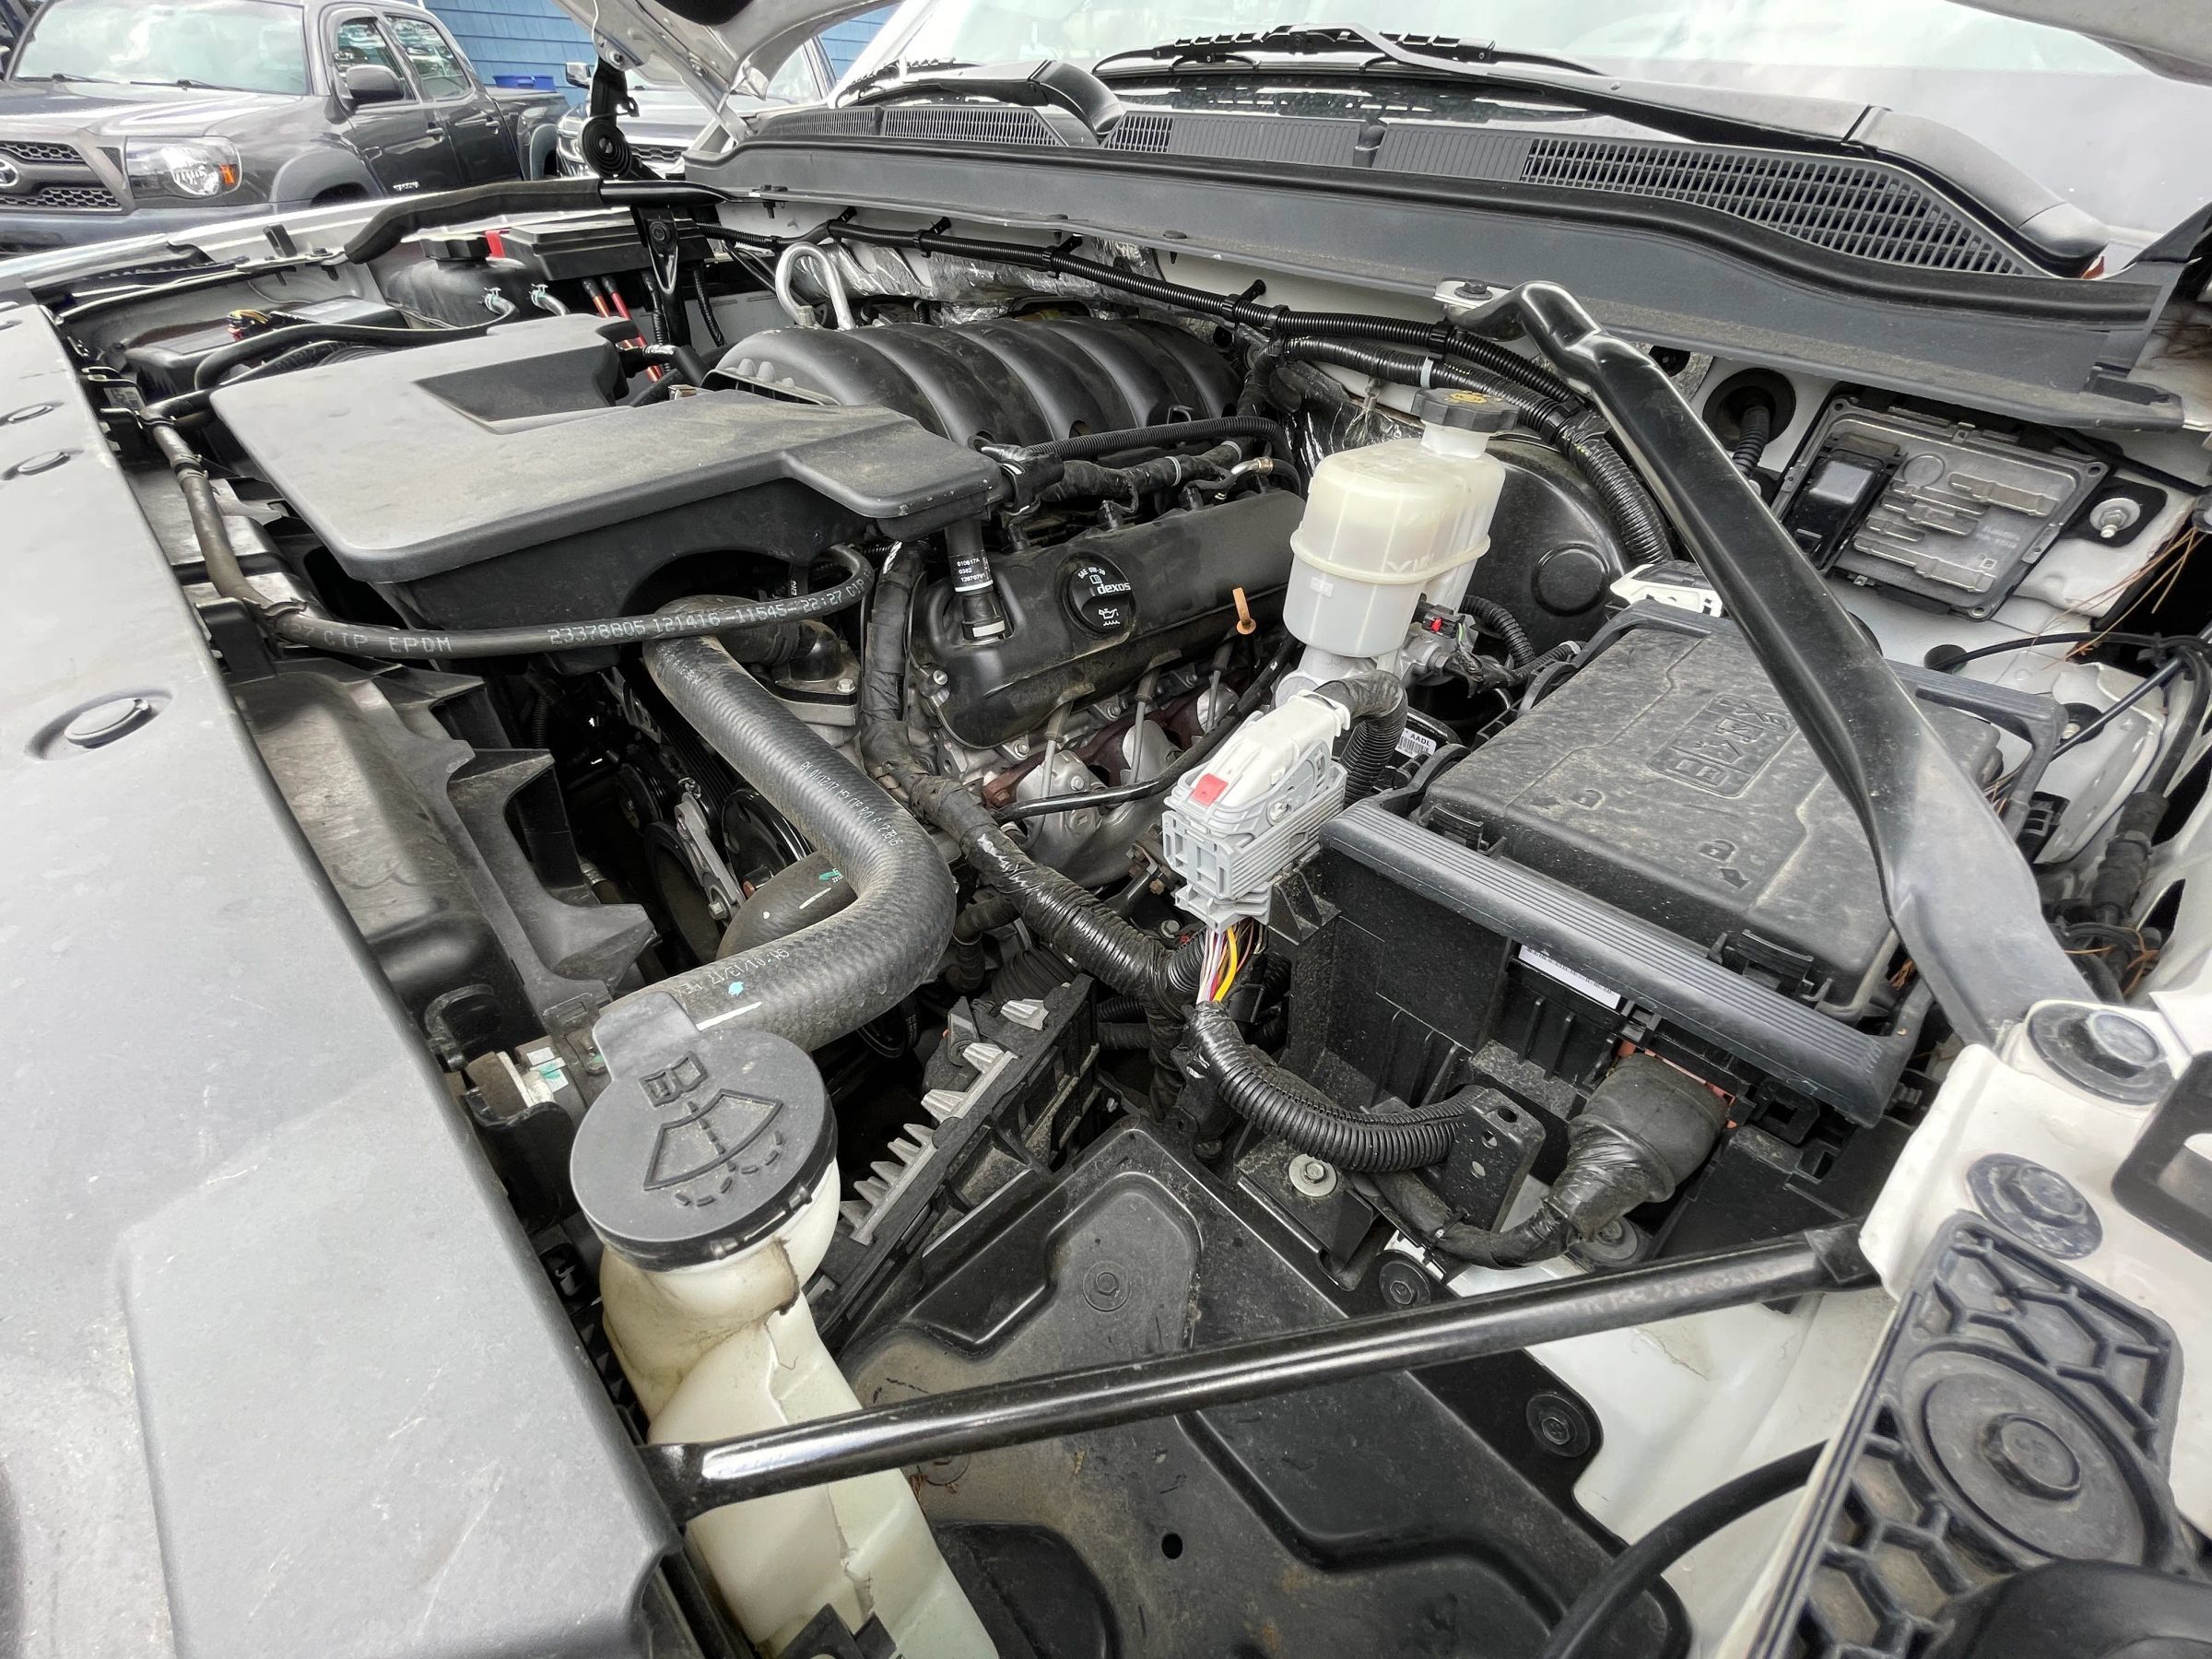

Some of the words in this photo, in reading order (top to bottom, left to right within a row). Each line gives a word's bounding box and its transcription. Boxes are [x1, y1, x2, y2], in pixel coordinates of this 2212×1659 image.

[1077, 568, 1089, 579] SAE
[1097, 582, 1132, 595] dexos
[388, 636, 453, 653] EPDM
